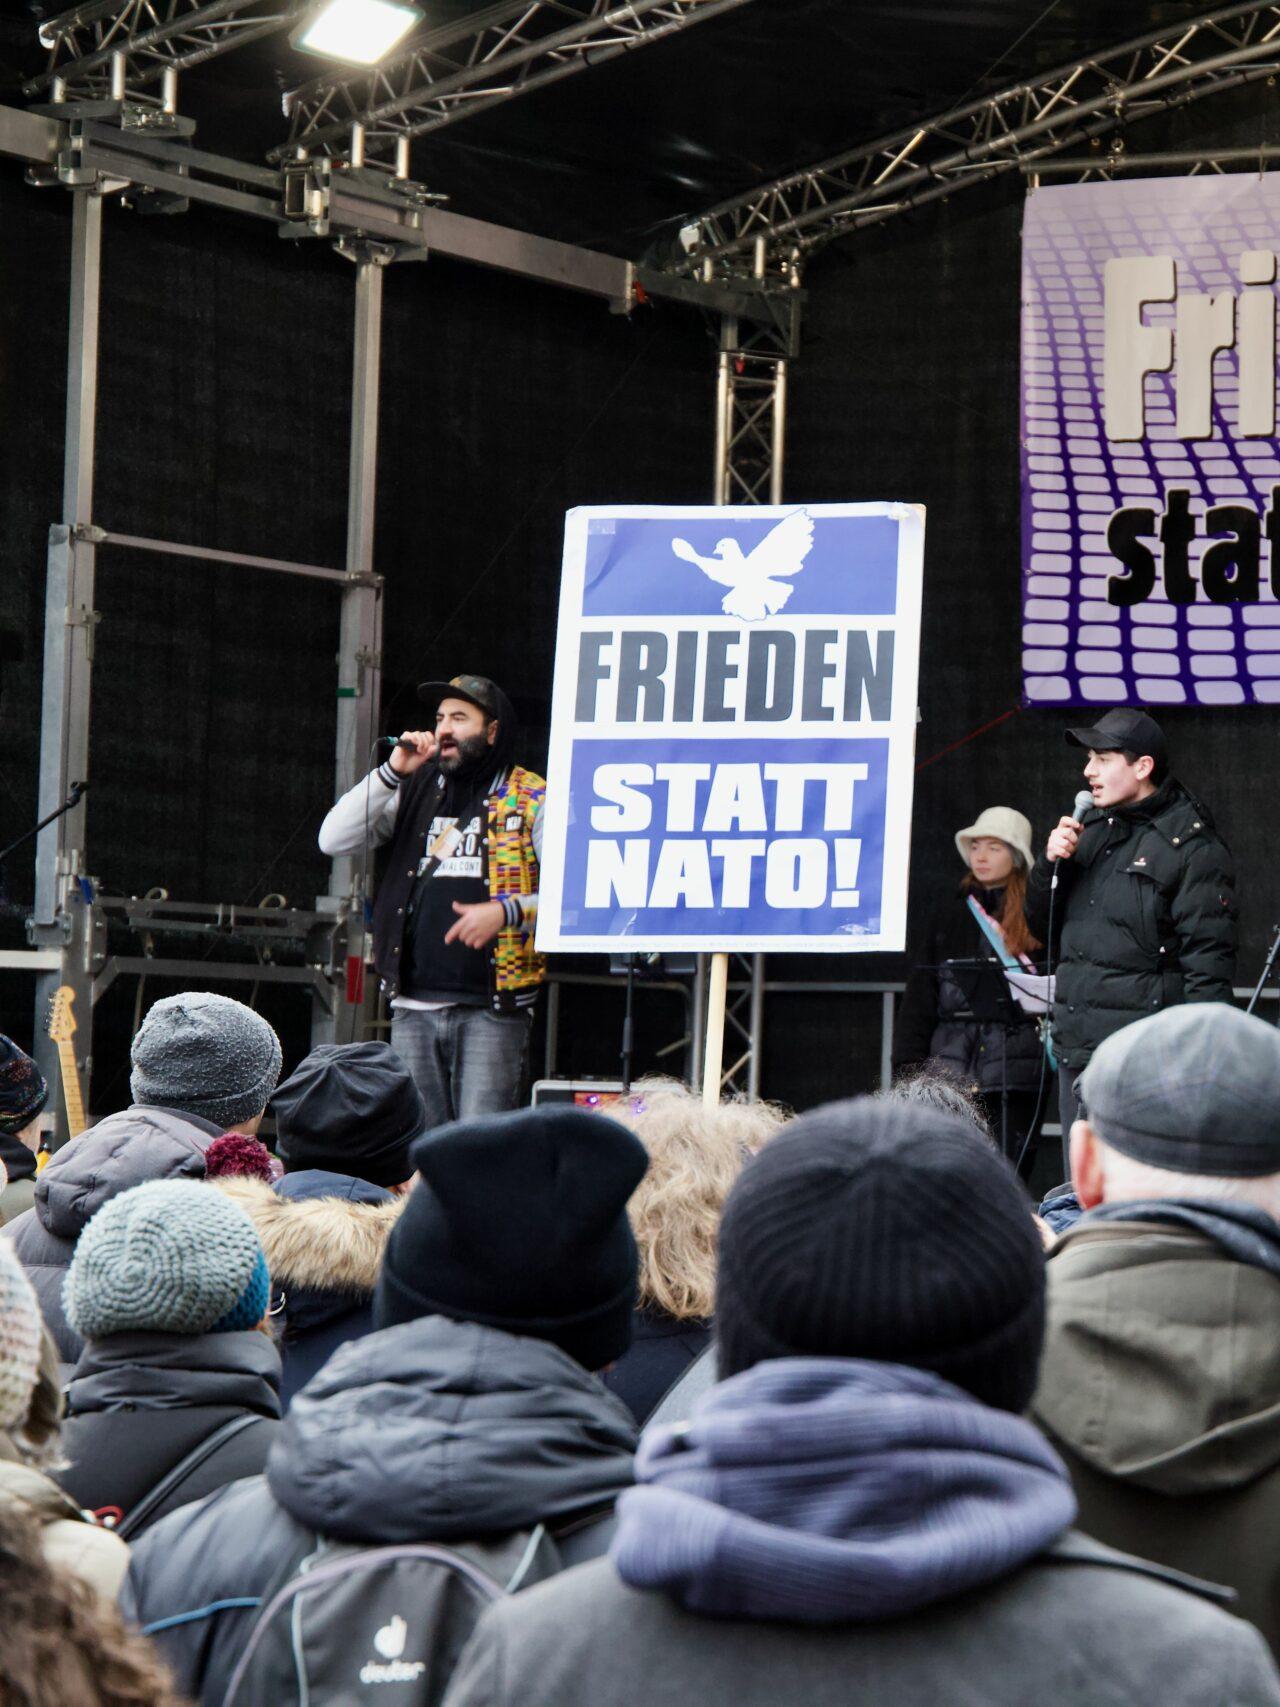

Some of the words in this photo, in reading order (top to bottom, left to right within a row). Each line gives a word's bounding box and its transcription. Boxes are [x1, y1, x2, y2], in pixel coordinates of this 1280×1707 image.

[574, 629, 896, 723] FRIEDEN
[590, 763, 869, 833] STATT
[584, 838, 862, 909] NATO!
